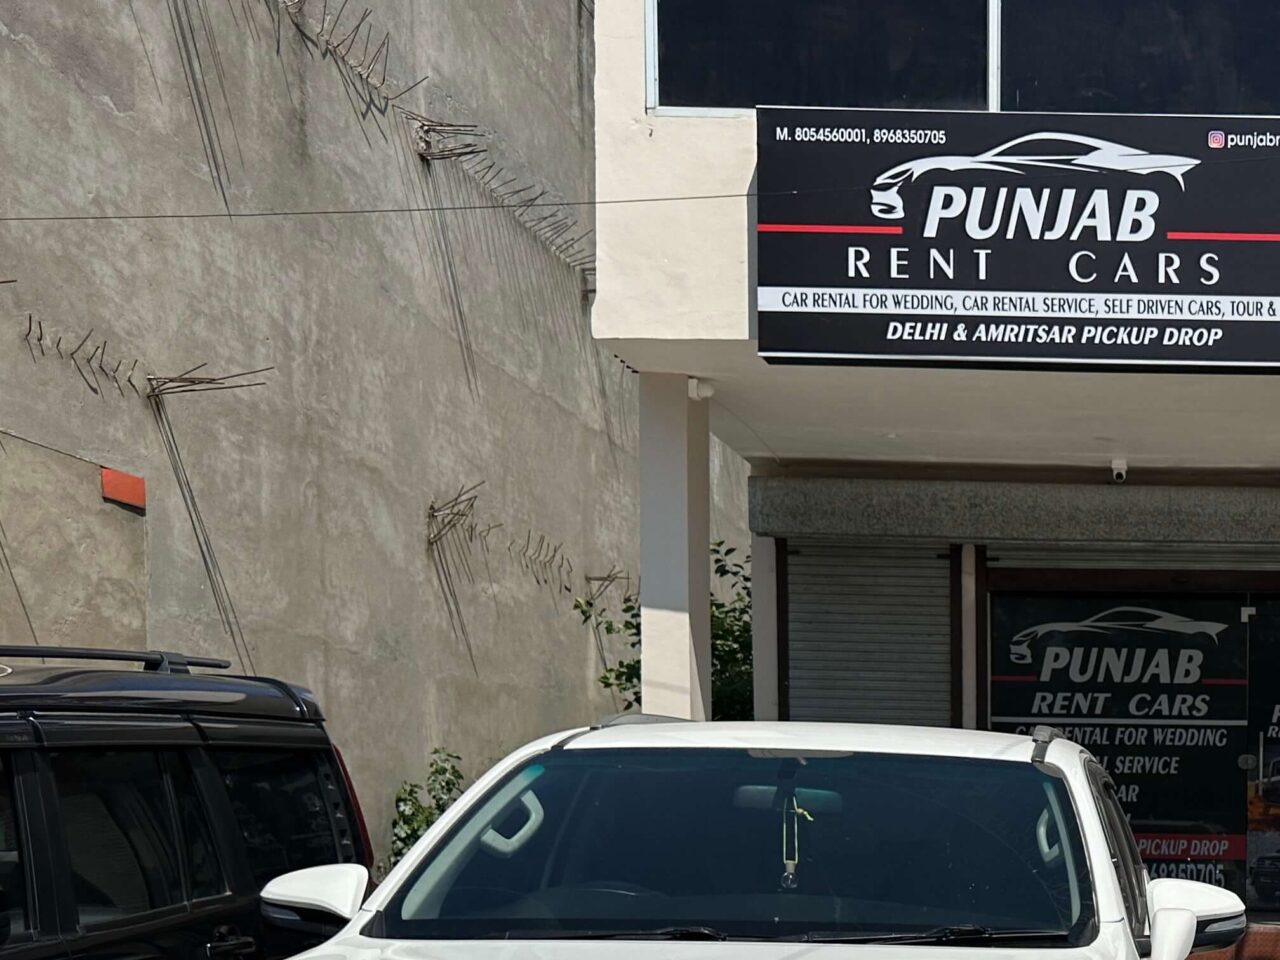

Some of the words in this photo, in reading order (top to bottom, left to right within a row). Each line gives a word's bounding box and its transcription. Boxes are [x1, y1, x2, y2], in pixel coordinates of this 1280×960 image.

[775, 127, 791, 141] M.
[794, 127, 870, 144] 8054560001,
[873, 129, 947, 144] 8968350705
[923, 186, 1160, 242] PUNJAB
[847, 246, 992, 280] RENT
[1068, 250, 1220, 285] CARS
[782, 291, 808, 308] CAR
[812, 292, 858, 309] RENTAL
[863, 293, 888, 310] FOR
[892, 294, 957, 313] WEDDING,
[962, 295, 988, 311] CAR
[993, 296, 1039, 312] RENTAL
[1043, 297, 1098, 316] SERVICE,
[1104, 298, 1133, 314] SELF
[1138, 299, 1183, 315] DRIVEN
[1188, 300, 1225, 318] CARS,
[1230, 300, 1263, 316] TOUR
[1267, 301, 1276, 317] &
[887, 321, 948, 341] DELHI
[953, 323, 968, 341] &
[972, 324, 1076, 344] AMRITSAR
[1081, 326, 1158, 345] PICKUP
[1163, 328, 1223, 346] DROP
[1039, 646, 1203, 684] PUNJAB
[1031, 692, 1111, 715] RENT
[1128, 693, 1210, 716] CARS
[1115, 727, 1148, 745] FOR
[1153, 728, 1228, 747] WEDDING
[1114, 756, 1180, 774] SERVICE
[1113, 784, 1139, 802] AR
[1138, 839, 1188, 855] PICKUP
[1190, 840, 1229, 856] DROP
